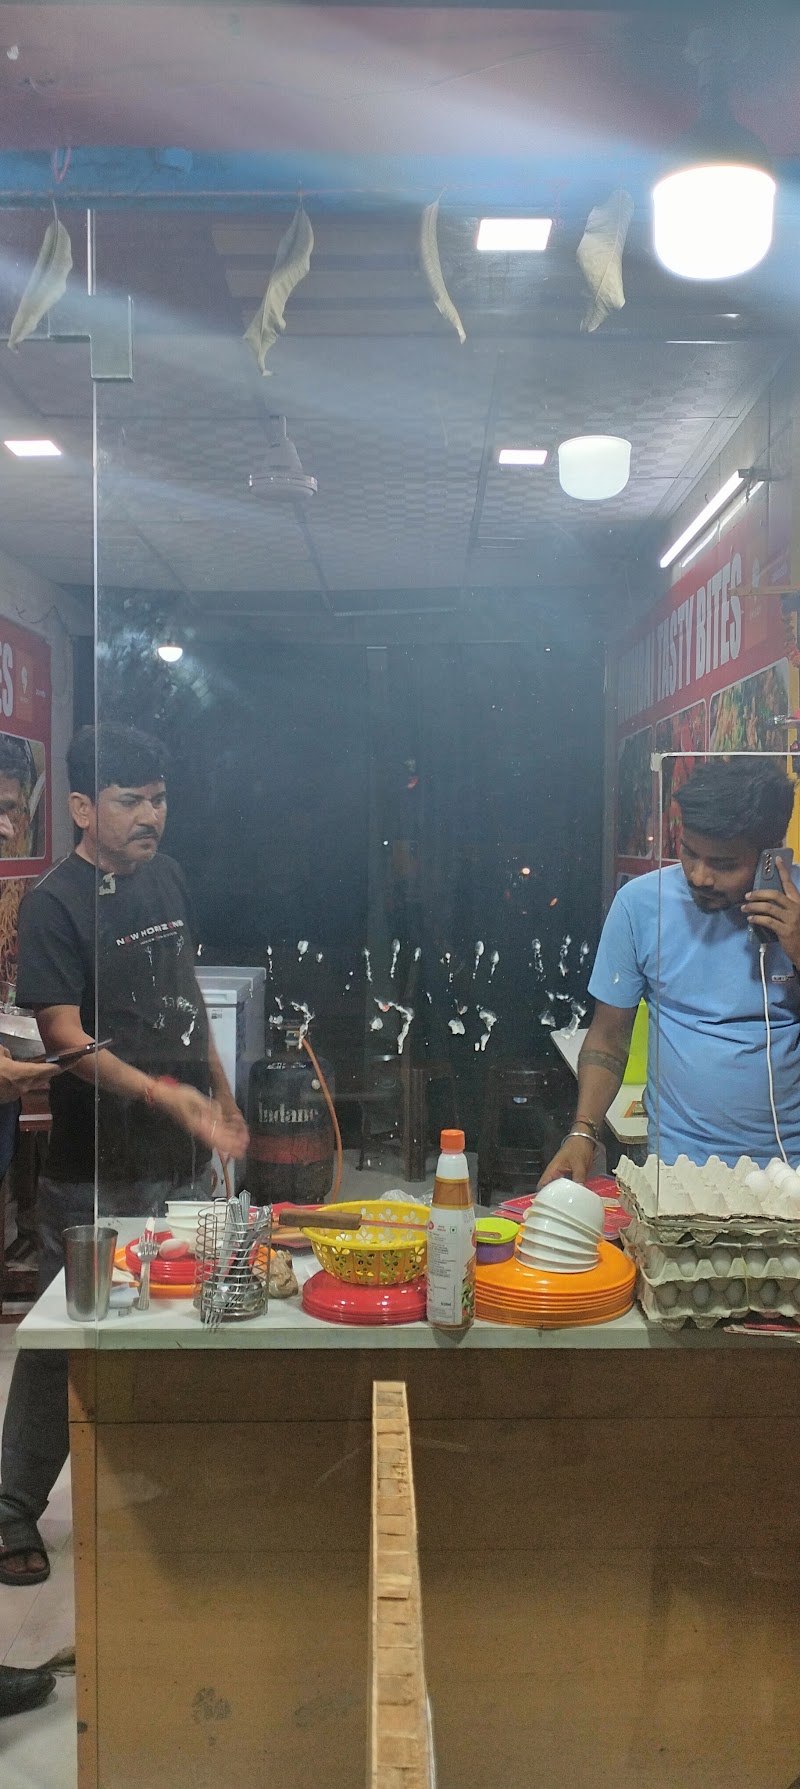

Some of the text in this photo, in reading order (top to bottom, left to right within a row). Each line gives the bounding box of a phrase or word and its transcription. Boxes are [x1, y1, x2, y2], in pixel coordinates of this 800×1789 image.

[657, 594, 694, 702] TASTY
[696, 553, 741, 680] BITES
[0, 640, 13, 717] S
[116, 932, 139, 946] NEW
